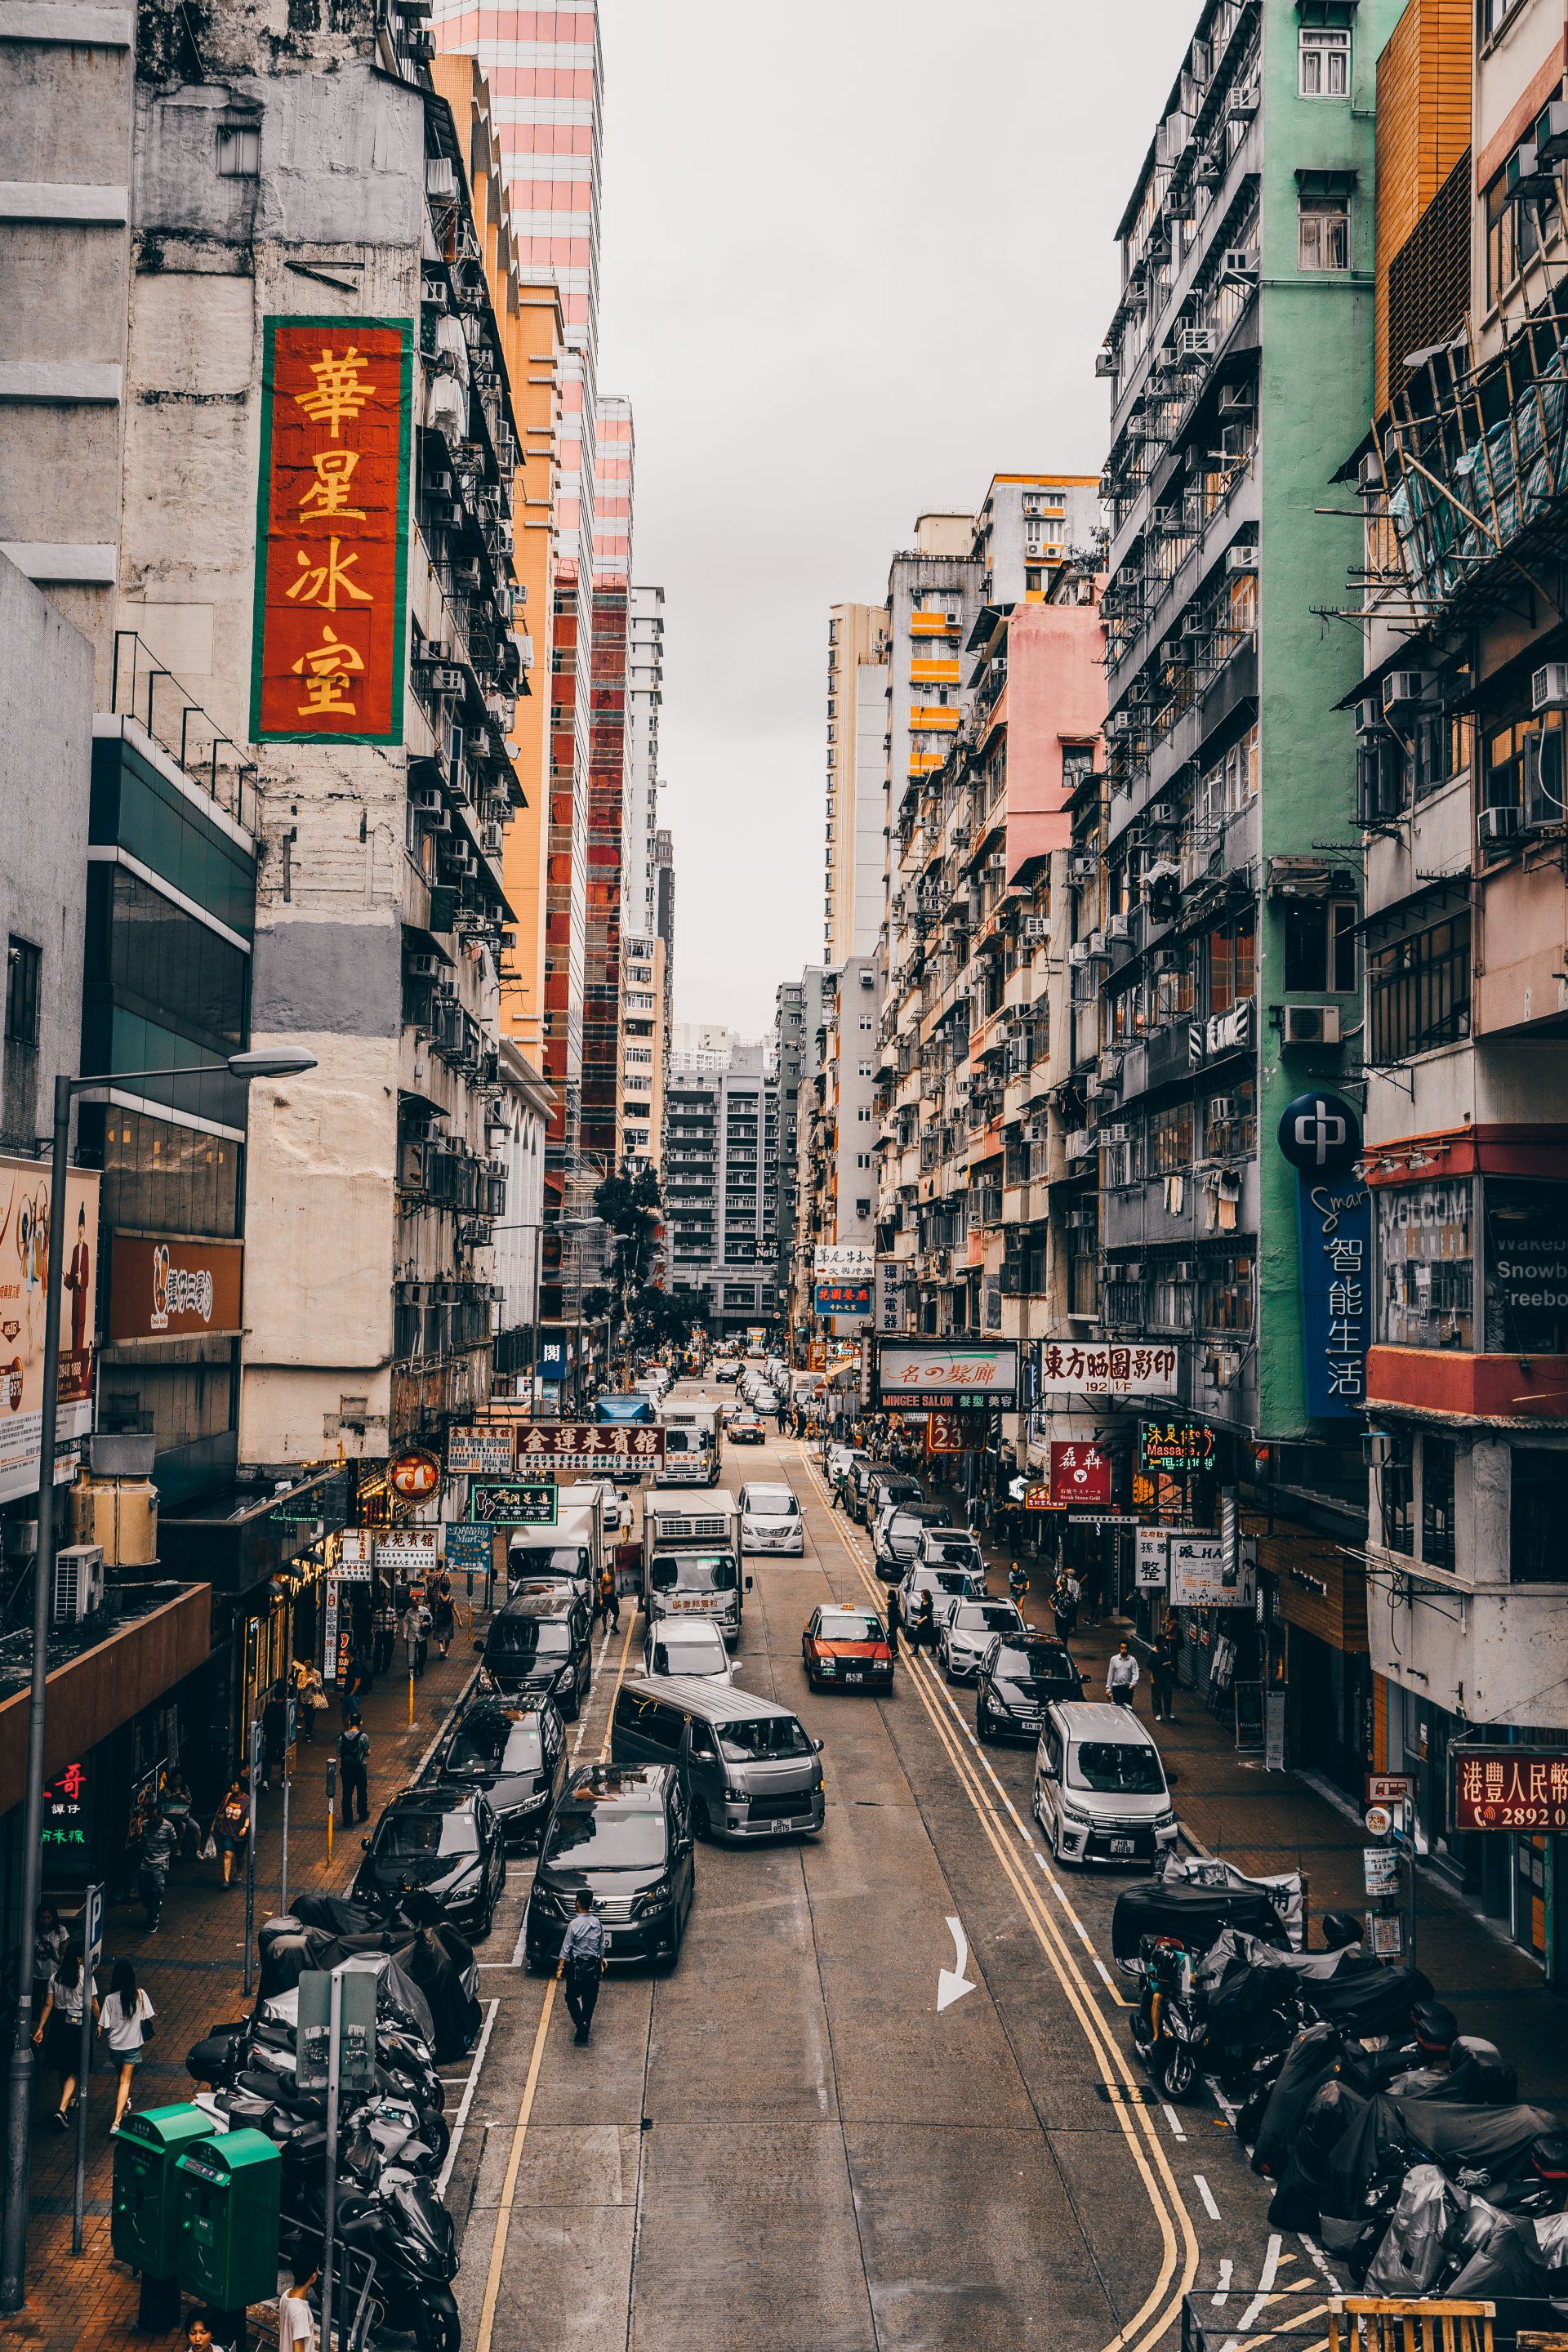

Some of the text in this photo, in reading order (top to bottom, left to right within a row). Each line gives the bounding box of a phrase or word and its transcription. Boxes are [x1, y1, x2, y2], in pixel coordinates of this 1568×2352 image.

[285, 345, 376, 716] 華星冰室
[1294, 1100, 1346, 1165] 中
[1386, 1187, 1467, 1231] VOLCOM
[818, 1288, 869, 1302] 花園餐廳
[884, 1264, 899, 1330] 環球電器
[1323, 1236, 1363, 1395] 智能生活
[1044, 1345, 1176, 1382] 東方晒圖影印
[1085, 1381, 1133, 1392] 192 1/F
[882, 1395, 1013, 1408] MINGEE SALON 髮型 美容
[450, 1437, 510, 1448] GOLDEN FORTUNE GUESTHOUSE
[933, 1427, 963, 1448] 23
[499, 1459, 510, 1468] PRICE
[376, 1532, 435, 1548] 麗苑賓館
[447, 1526, 489, 1539] Dreamy
[455, 1534, 483, 1544] Mart
[1463, 1761, 1568, 1804] 港豐人民幣
[51, 1803, 81, 1815] 譚仔
[1404, 1797, 1412, 1833] P
[1501, 1807, 1568, 1826] 2892 0
[92, 1892, 102, 1944] P
